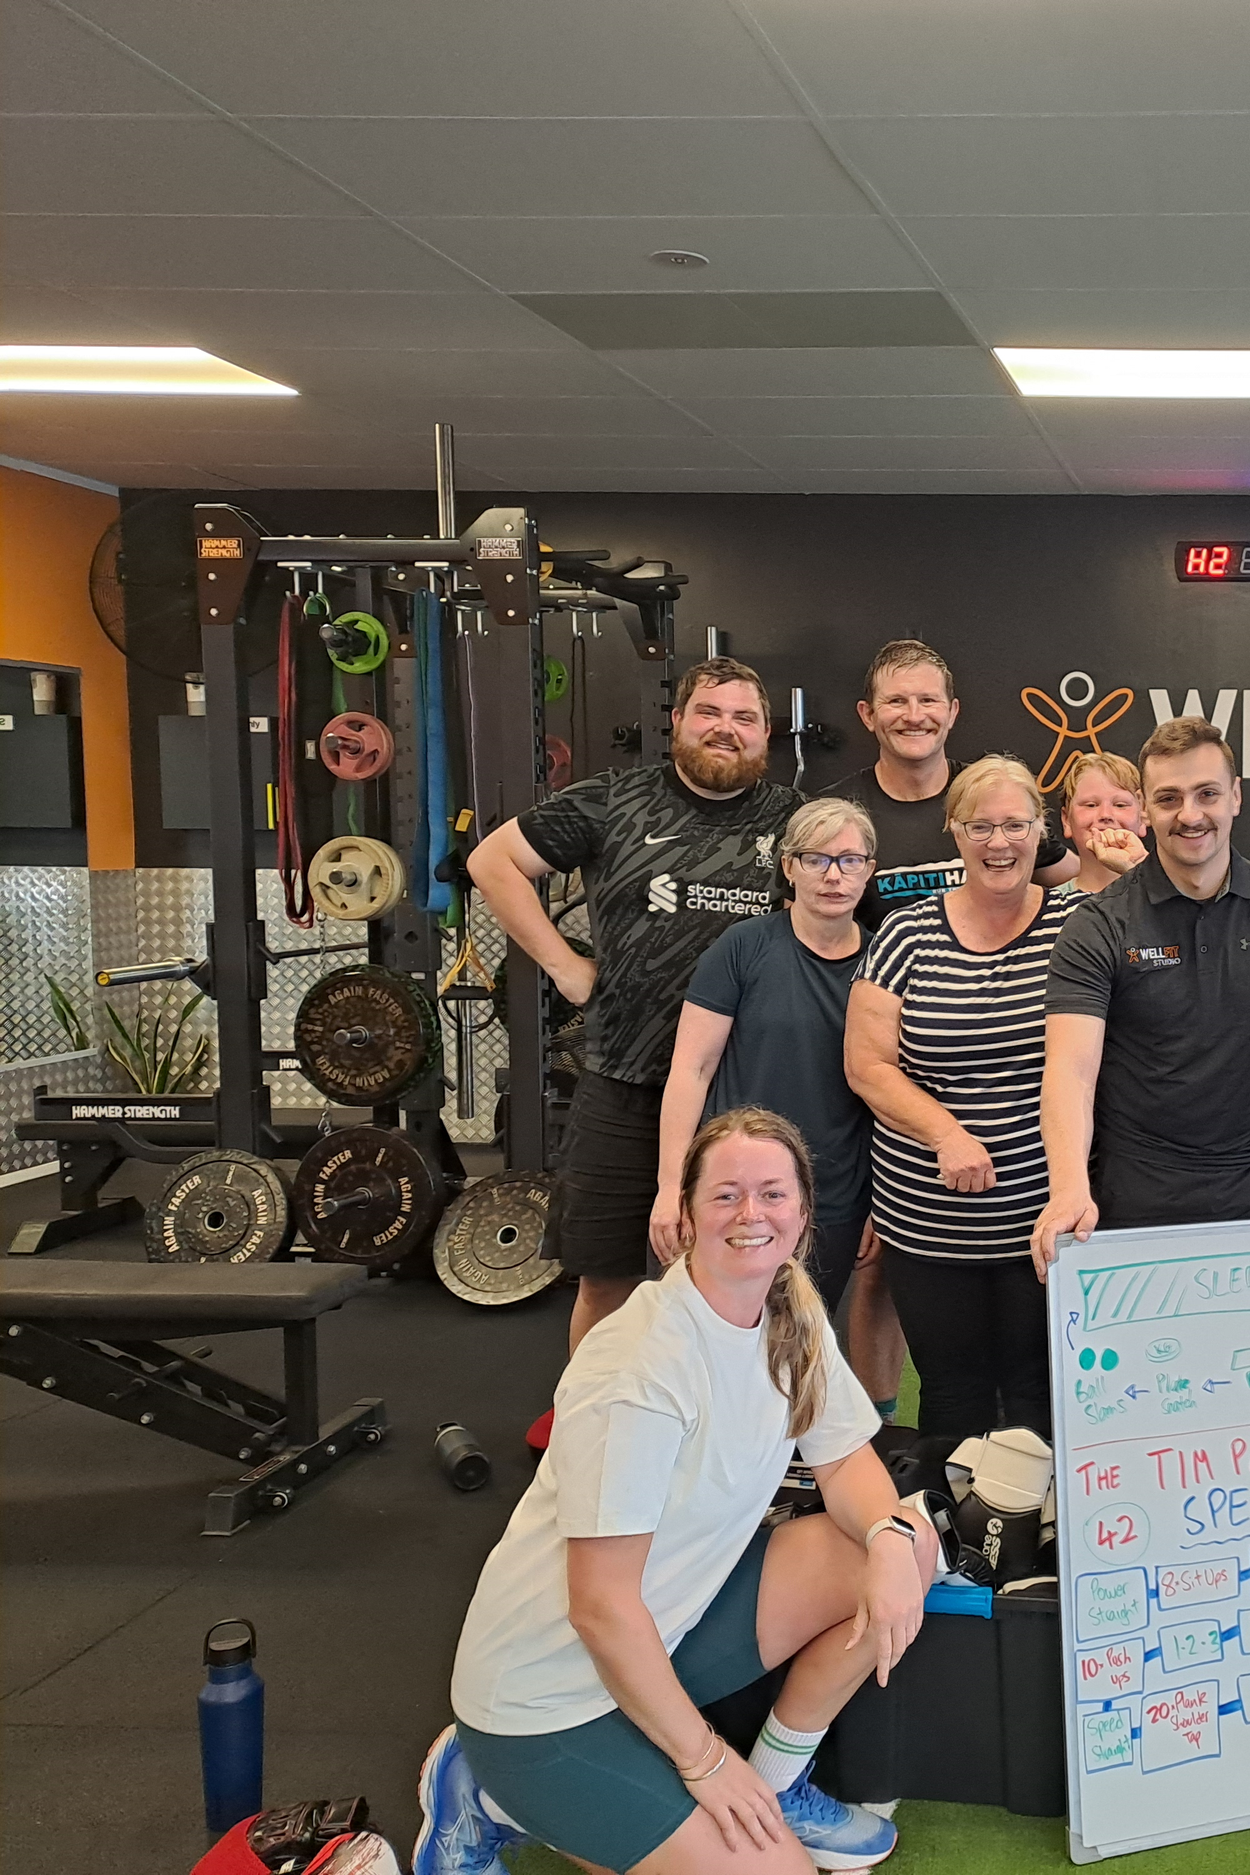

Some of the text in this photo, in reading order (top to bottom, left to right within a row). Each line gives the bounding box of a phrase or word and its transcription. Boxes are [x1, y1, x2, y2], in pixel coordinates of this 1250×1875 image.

[201, 547, 240, 557] STRENGTH
[202, 539, 238, 548] HAMMER
[480, 548, 519, 557] STRENGTH
[481, 539, 517, 549] HAMMER
[686, 883, 770, 904] standard
[686, 898, 772, 916] chartered
[1153, 957, 1181, 967] STUDIO
[327, 986, 403, 1017] AGAIN FASTER
[72, 1105, 180, 1119] HAMMER STRENGTH
[313, 1149, 352, 1219] AGAIN FASTER
[163, 1175, 202, 1253] AGAIN FASTER
[372, 1176, 412, 1246] AGAIN FASTER
[230, 1188, 267, 1264] AGAIN FASTER
[453, 1216, 489, 1284] AGAIN FASTER
[1075, 1461, 1121, 1496] THE
[1146, 1447, 1215, 1490] TIM
[1097, 1515, 1138, 1550] 42
[1090, 1577, 1128, 1602] Power
[1088, 1599, 1139, 1627] Straight
[1175, 1690, 1208, 1714] Plank
[1182, 1730, 1202, 1749] Tap
